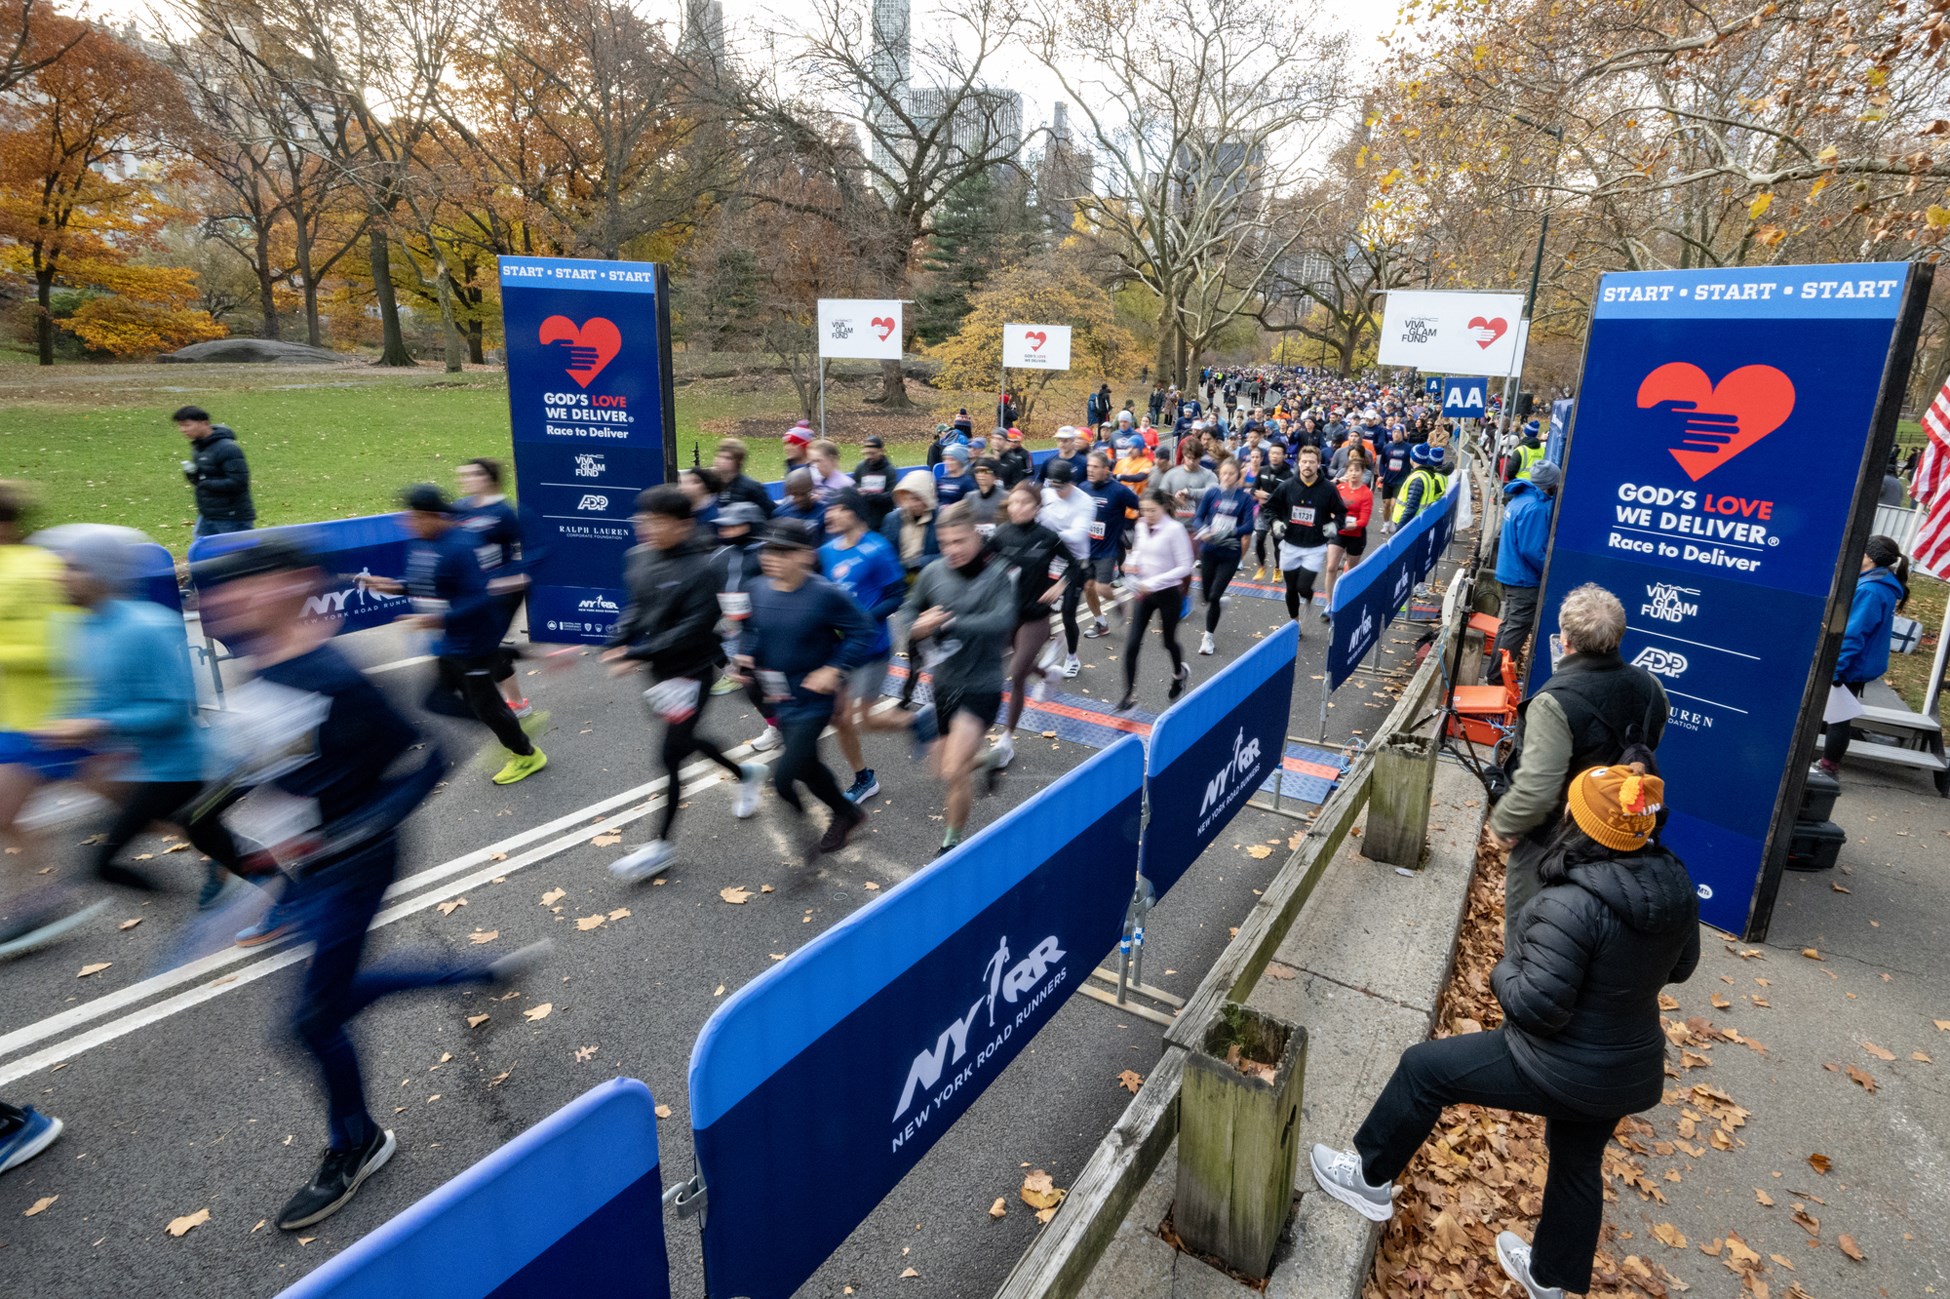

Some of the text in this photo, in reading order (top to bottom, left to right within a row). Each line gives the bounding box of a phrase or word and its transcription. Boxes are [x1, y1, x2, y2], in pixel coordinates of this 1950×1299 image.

[503, 266, 650, 282] START START START
[1604, 280, 1897, 301] START START START
[1405, 320, 1425, 328] VIVA
[1409, 328, 1437, 336] GLAM
[1402, 334, 1427, 343] FUND
[1430, 381, 1437, 389] A
[544, 392, 626, 408] GOD'S LOVE
[1445, 387, 1483, 408] AA
[546, 408, 567, 419] WE
[546, 425, 628, 438] Race to Deliver
[575, 456, 594, 464] VIVA
[581, 463, 605, 471] GLAM
[576, 468, 599, 477] FUND
[577, 494, 608, 511] ADP
[1618, 483, 1774, 520] GOD'S LOVE
[1616, 506, 1652, 527] WE
[559, 525, 629, 536] RALPH LAUREN
[1608, 533, 1761, 572] Race to Deliver
[1646, 585, 1679, 602] VIVA
[324, 611, 349, 621] YORK
[354, 605, 379, 614] ROAD
[1641, 604, 1682, 623] FUND
[1653, 597, 1698, 616] GLAM
[1630, 646, 1688, 678] ADP
[1668, 718, 1698, 732] DATION
[1670, 707, 1714, 728] UREN
[1197, 762, 1260, 836] NEW YORK ROAD RUNNERS
[892, 967, 1067, 1153] NEW YORK ROAD RUNNERS
